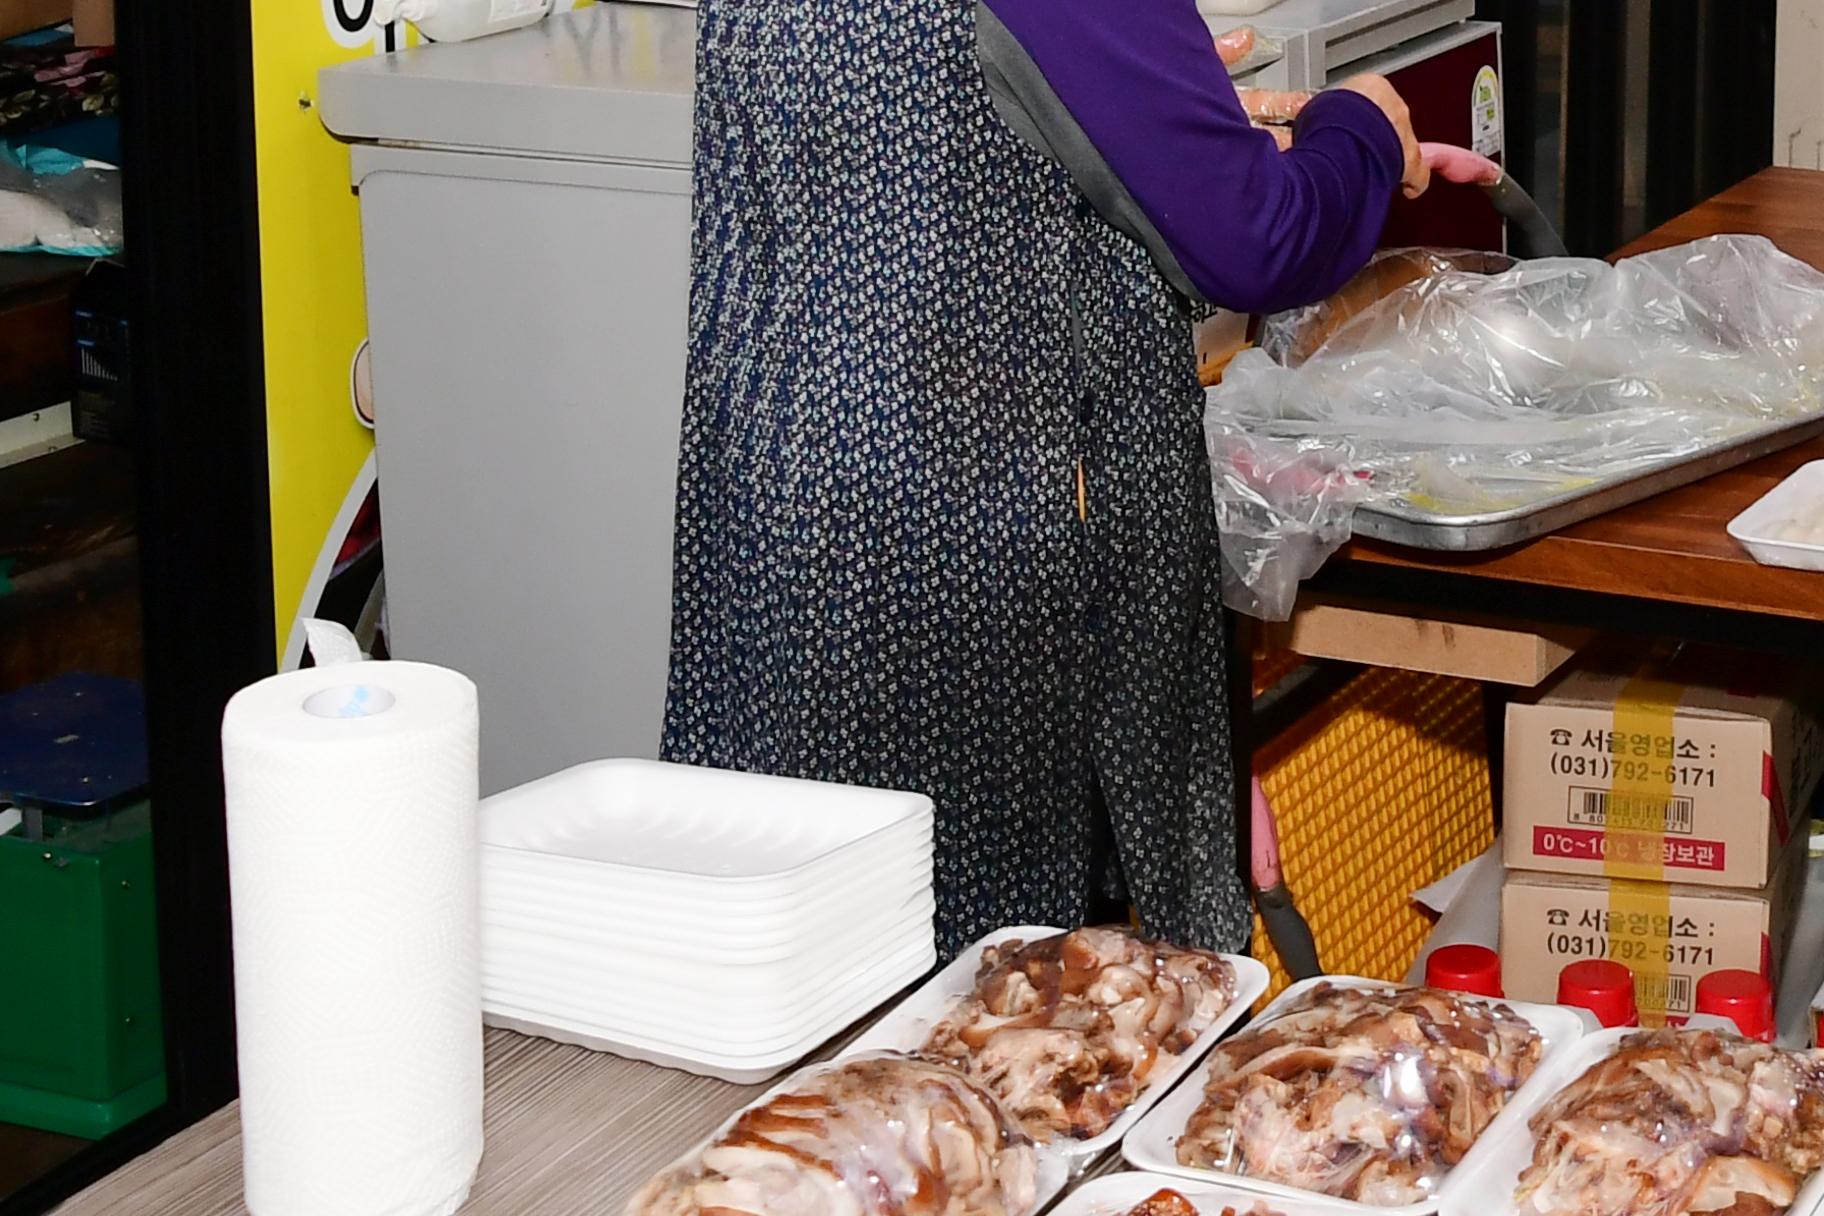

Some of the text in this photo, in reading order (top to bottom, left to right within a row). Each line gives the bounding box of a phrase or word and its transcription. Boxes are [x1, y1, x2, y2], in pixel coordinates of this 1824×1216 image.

[1580, 729, 1701, 761] 서울영업소
[1549, 752, 1716, 788] (031)792-6171
[1637, 839, 1715, 867] 냉장보관
[1577, 909, 1699, 938] 서울영업소
[1546, 932, 1714, 967] (031)792-6171
